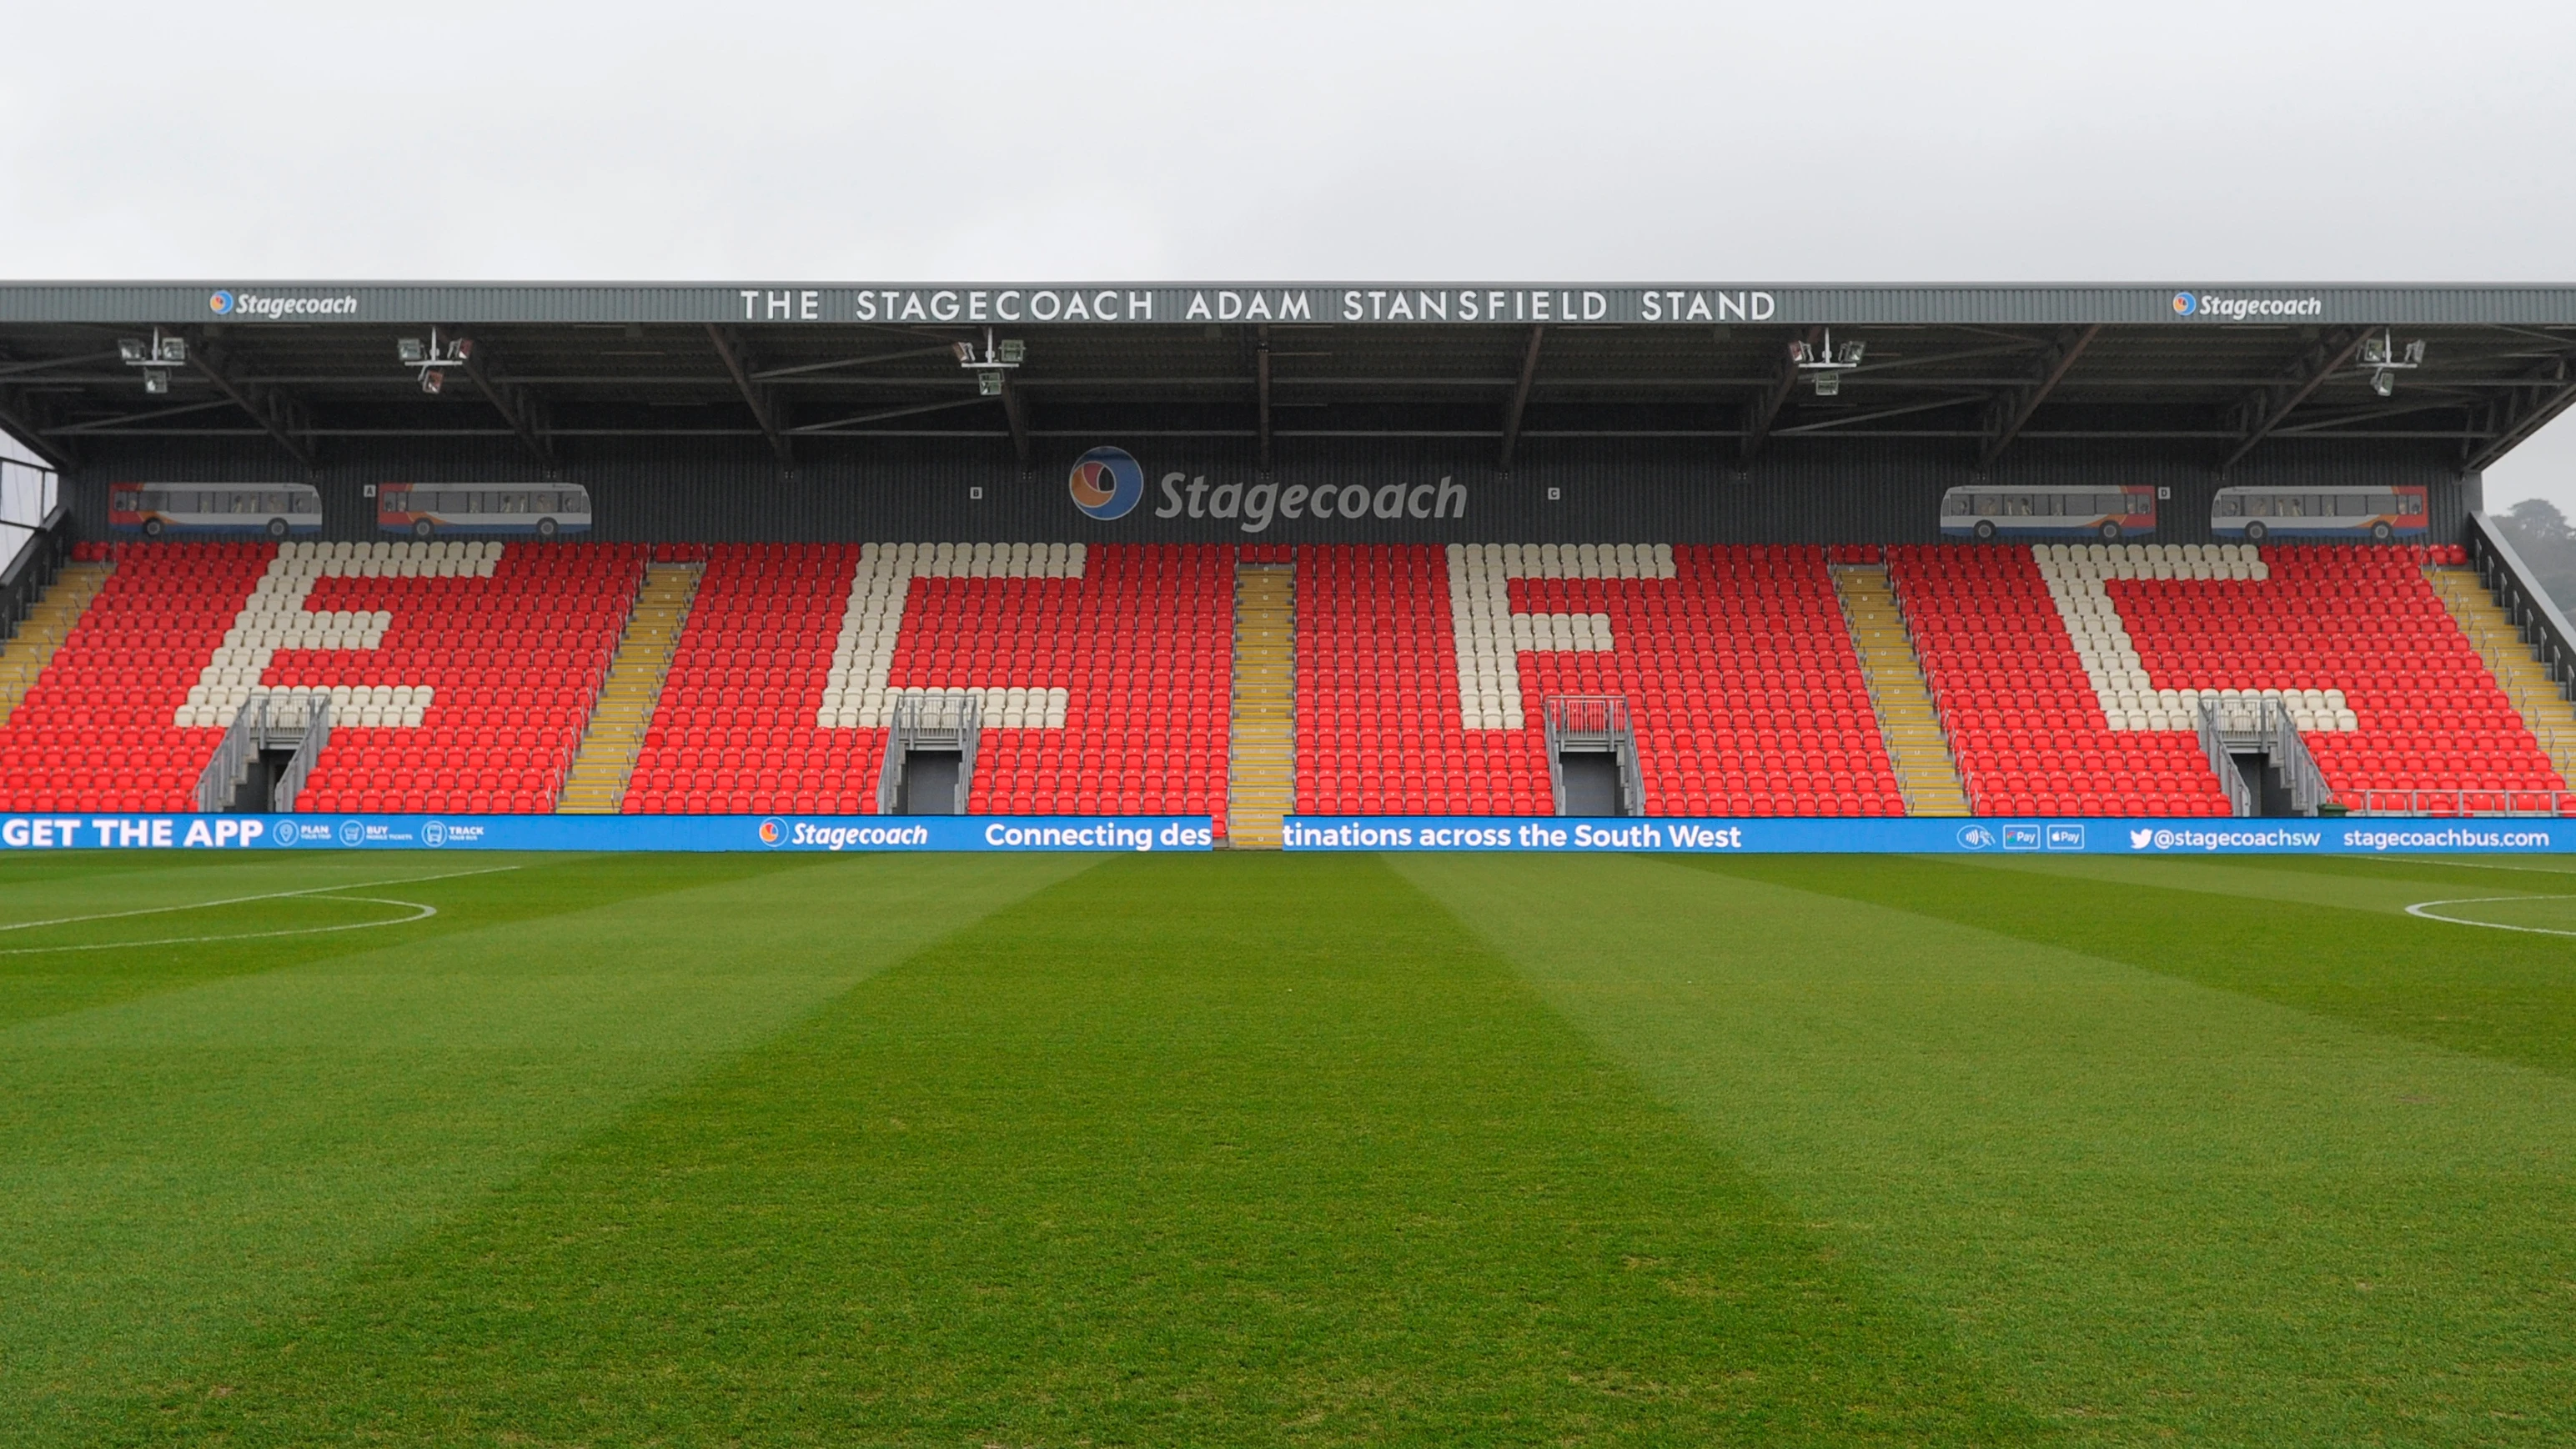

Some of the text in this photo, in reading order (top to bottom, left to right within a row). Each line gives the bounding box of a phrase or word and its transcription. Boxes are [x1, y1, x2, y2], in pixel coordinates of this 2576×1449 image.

[236, 293, 358, 319] Stagecoach
[741, 290, 1775, 322] THE STAGECOACH ADAM STANSFIELD STAND
[2198, 294, 2322, 320] Stagecoach
[1155, 473, 1468, 533] Stagecoach
[3, 819, 264, 847] GET THE APP
[300, 825, 329, 834] PLAN
[366, 825, 389, 835] BUY
[449, 826, 484, 835] TRACK
[791, 822, 928, 851] Stagecoach
[985, 822, 1212, 852] Connecting des
[1283, 821, 1742, 848] tinations across the South West
[2016, 831, 2036, 844] Pay
[2061, 831, 2080, 844] Pay
[2153, 827, 2321, 851] @stagecoachsw
[2343, 829, 2550, 851] stagecoachbus.com
